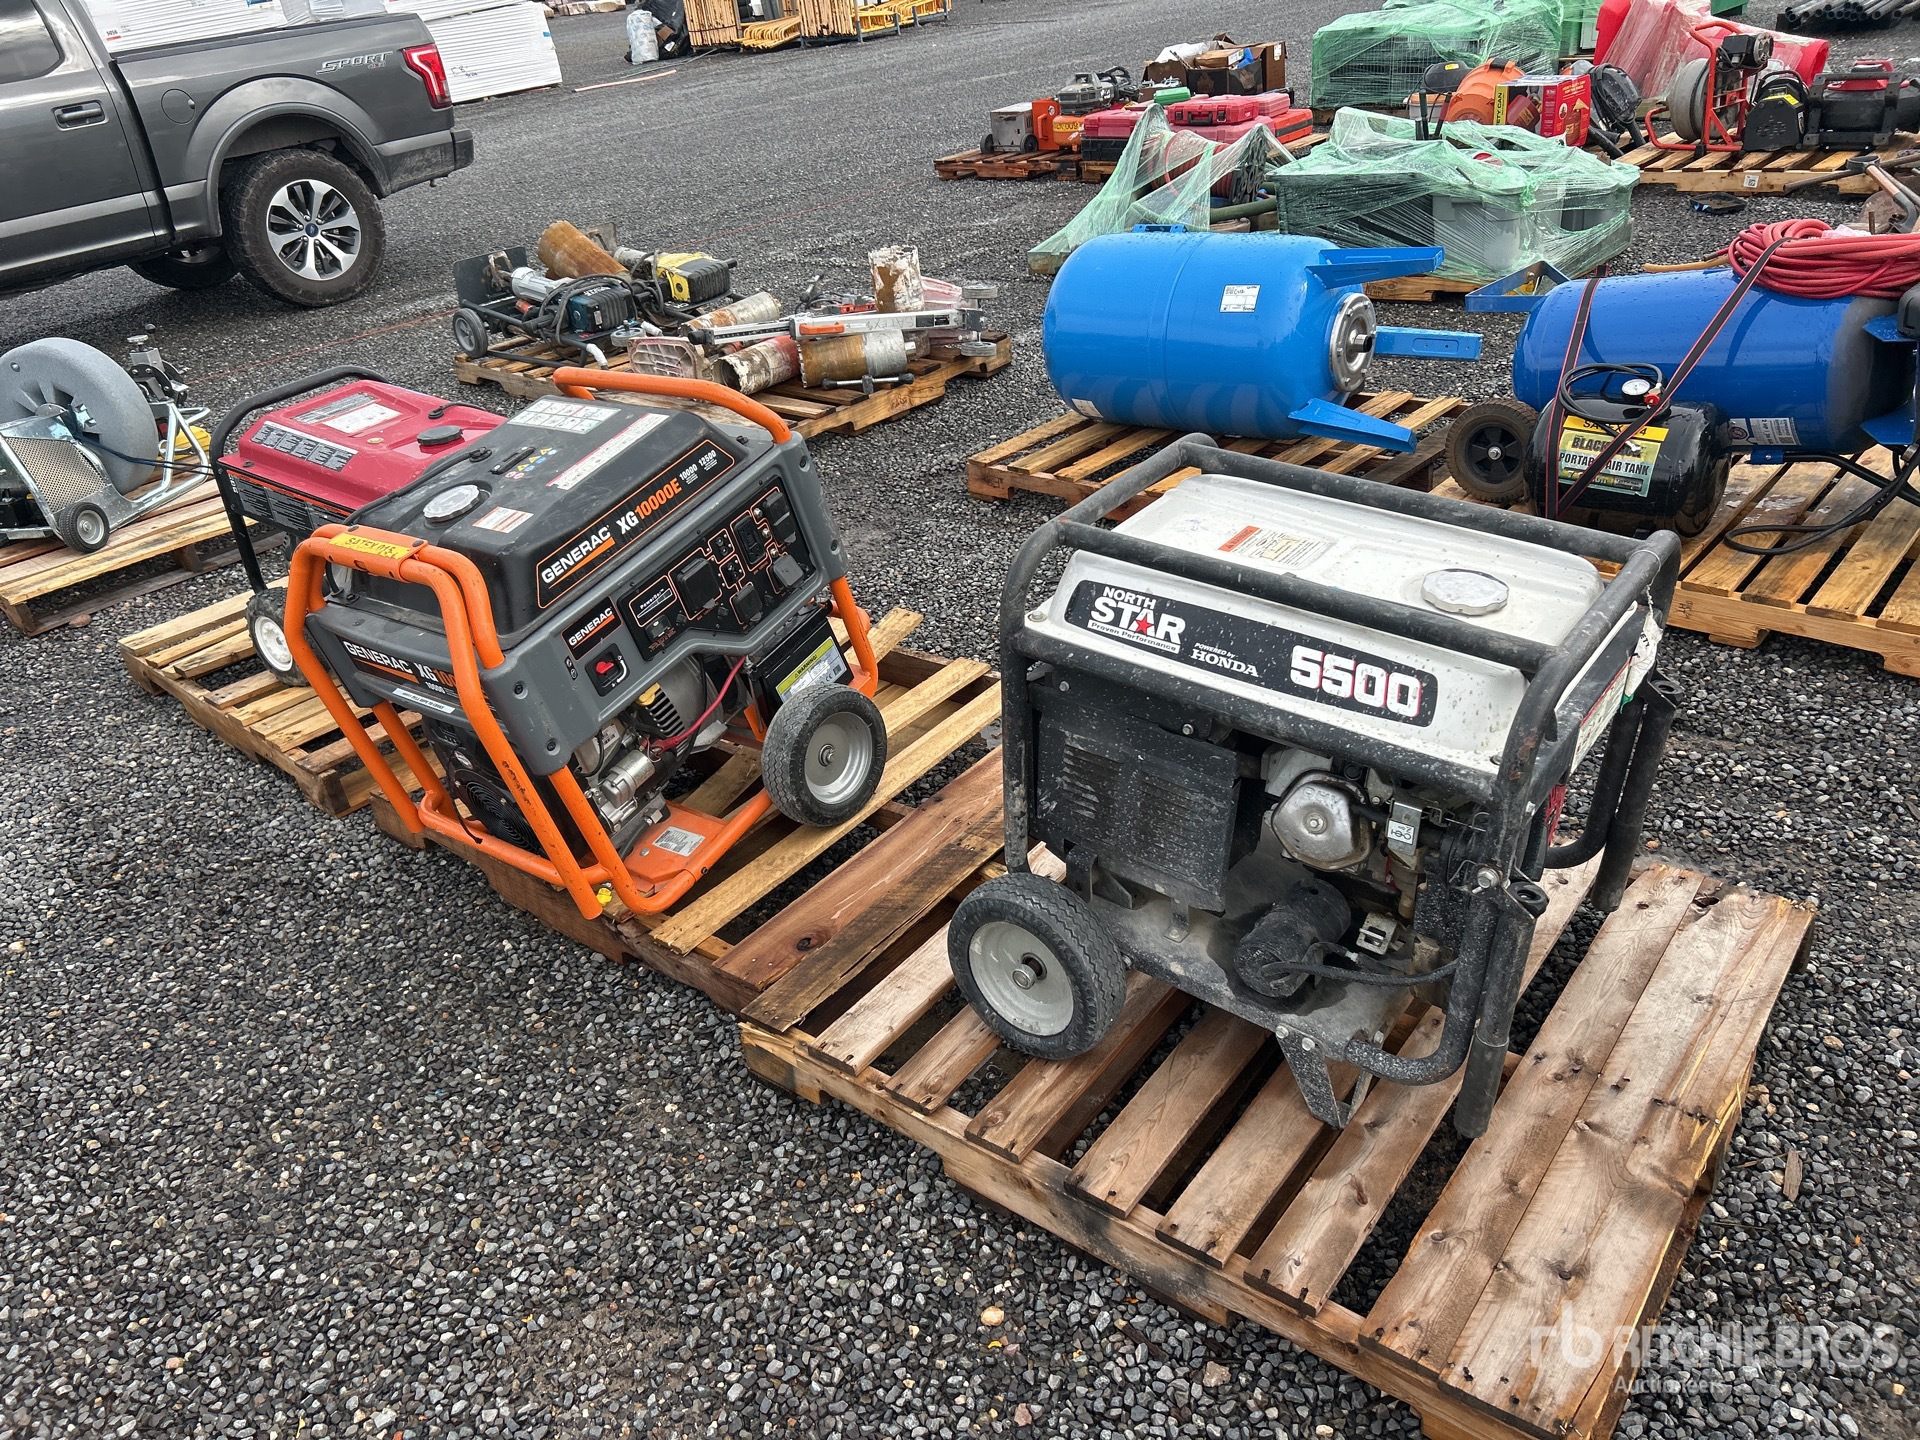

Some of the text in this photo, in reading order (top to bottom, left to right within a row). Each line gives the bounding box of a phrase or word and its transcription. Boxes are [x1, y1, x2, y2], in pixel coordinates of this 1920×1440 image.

[316, 51, 394, 75] SPORT
[1583, 419, 1622, 433] SAEX
[1606, 461, 1622, 472] AIR
[1625, 462, 1650, 476] TANK
[541, 526, 612, 585] GENERAC
[615, 477, 683, 535] XG10000E
[679, 463, 699, 481] 10000
[698, 449, 717, 467] 12500
[1102, 586, 1157, 610] NORTH
[568, 607, 613, 646] GENERAC
[1091, 596, 1186, 645] STAR
[1091, 621, 1177, 653] Proven Performance
[1194, 642, 1227, 656] POWERED
[343, 640, 413, 674] GENERAC
[1191, 648, 1260, 678] HONDA
[1290, 644, 1423, 718] 5500
